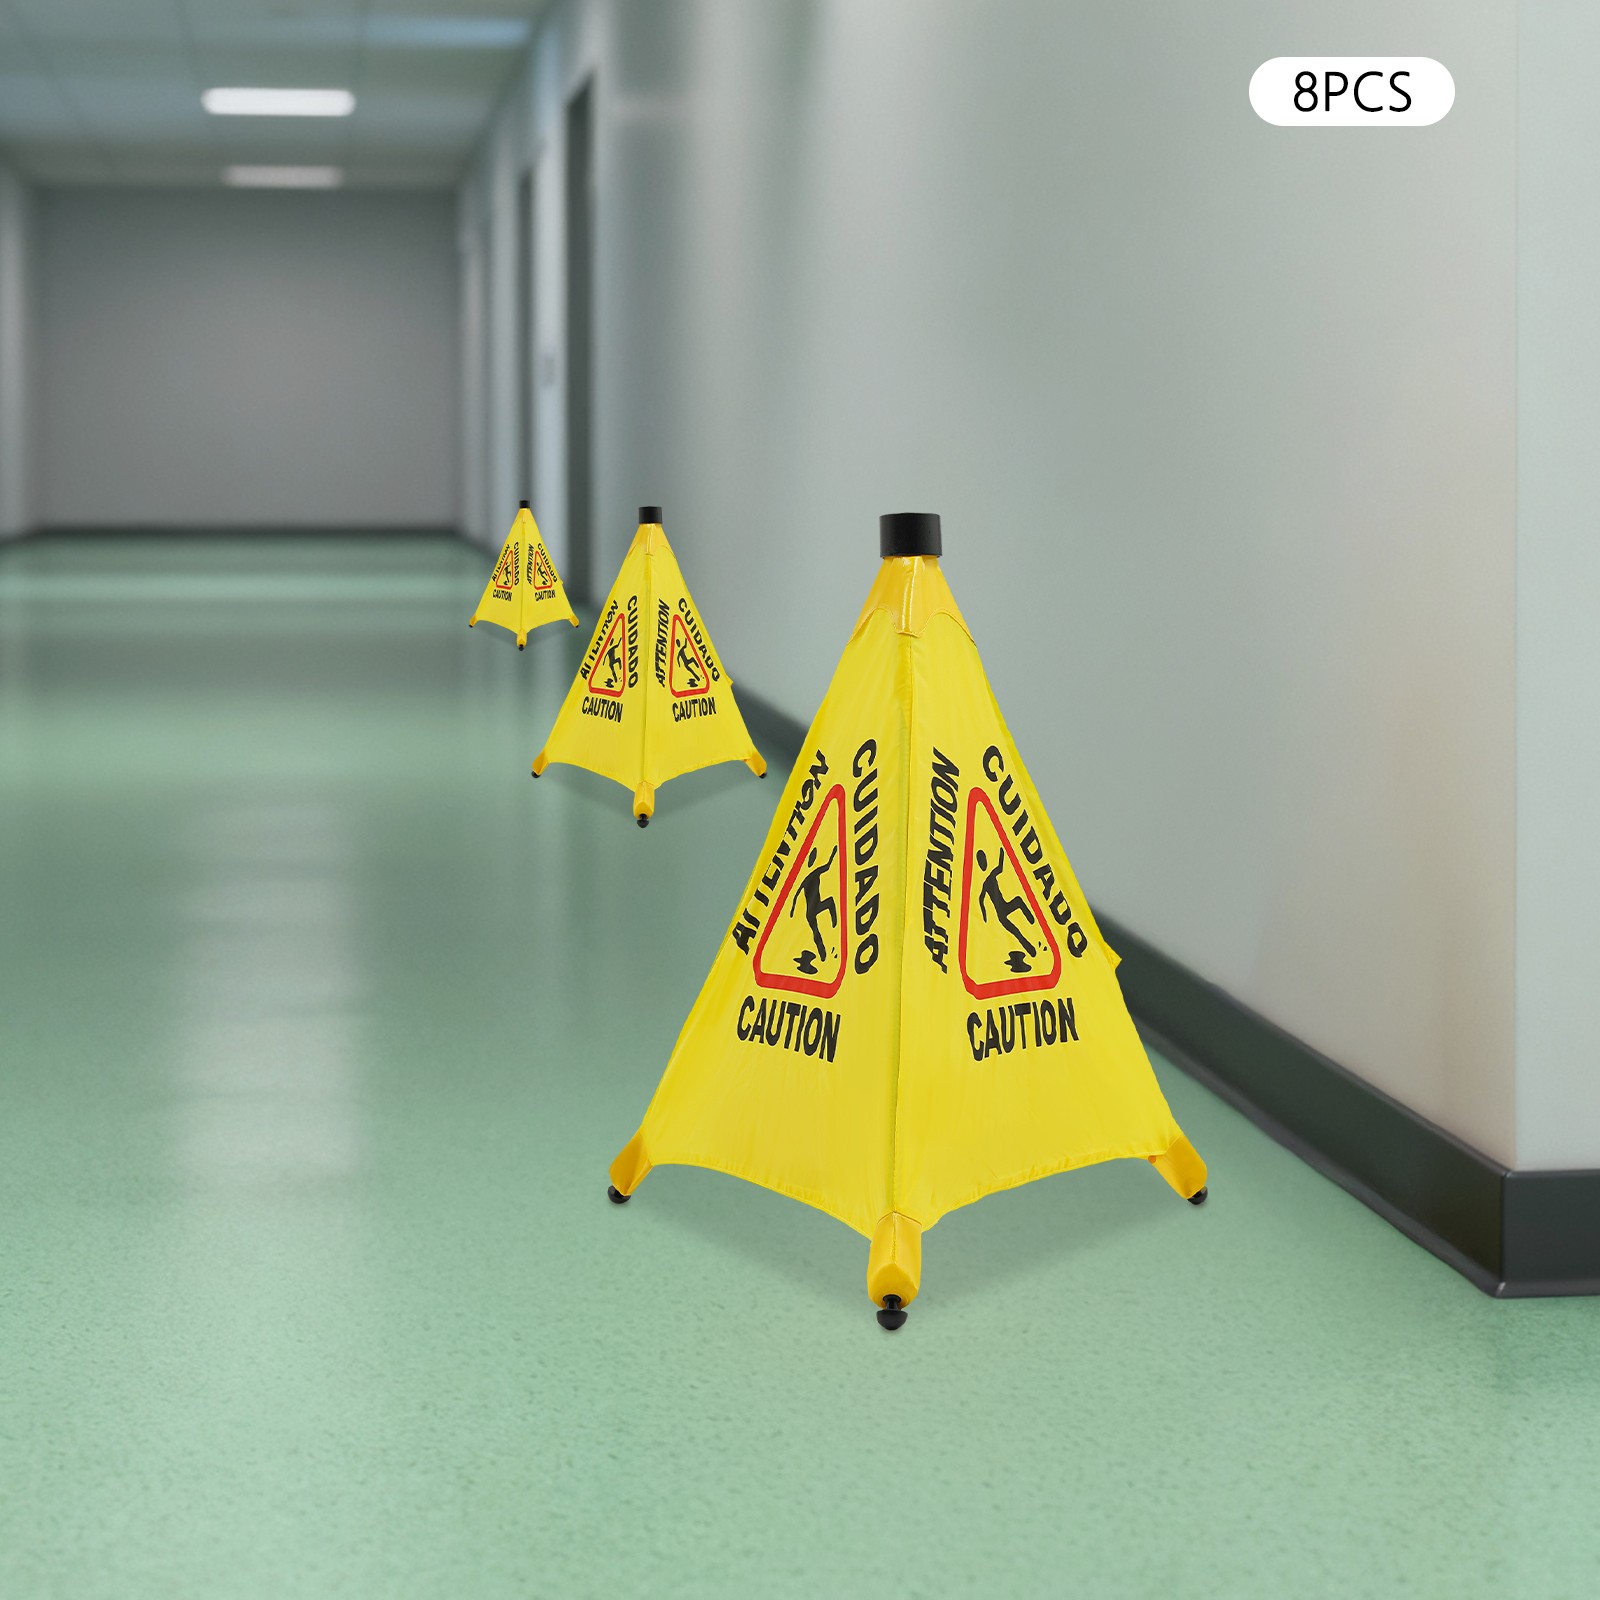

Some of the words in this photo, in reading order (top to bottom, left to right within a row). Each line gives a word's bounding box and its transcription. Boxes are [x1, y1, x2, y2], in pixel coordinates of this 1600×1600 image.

[627, 594, 638, 689] CUIDADO
[654, 598, 671, 688] ATTENTION
[678, 596, 721, 682] CUIDADO
[581, 696, 623, 723] CAUTION
[672, 696, 717, 723] CAUTION
[731, 749, 830, 956] ATTENTION
[852, 738, 880, 975] CUIDADO
[922, 746, 961, 974] ATTENTION
[981, 745, 1089, 959] CUIDADO
[736, 995, 842, 1064] CAUTION
[966, 997, 1080, 1063] CAUTION
